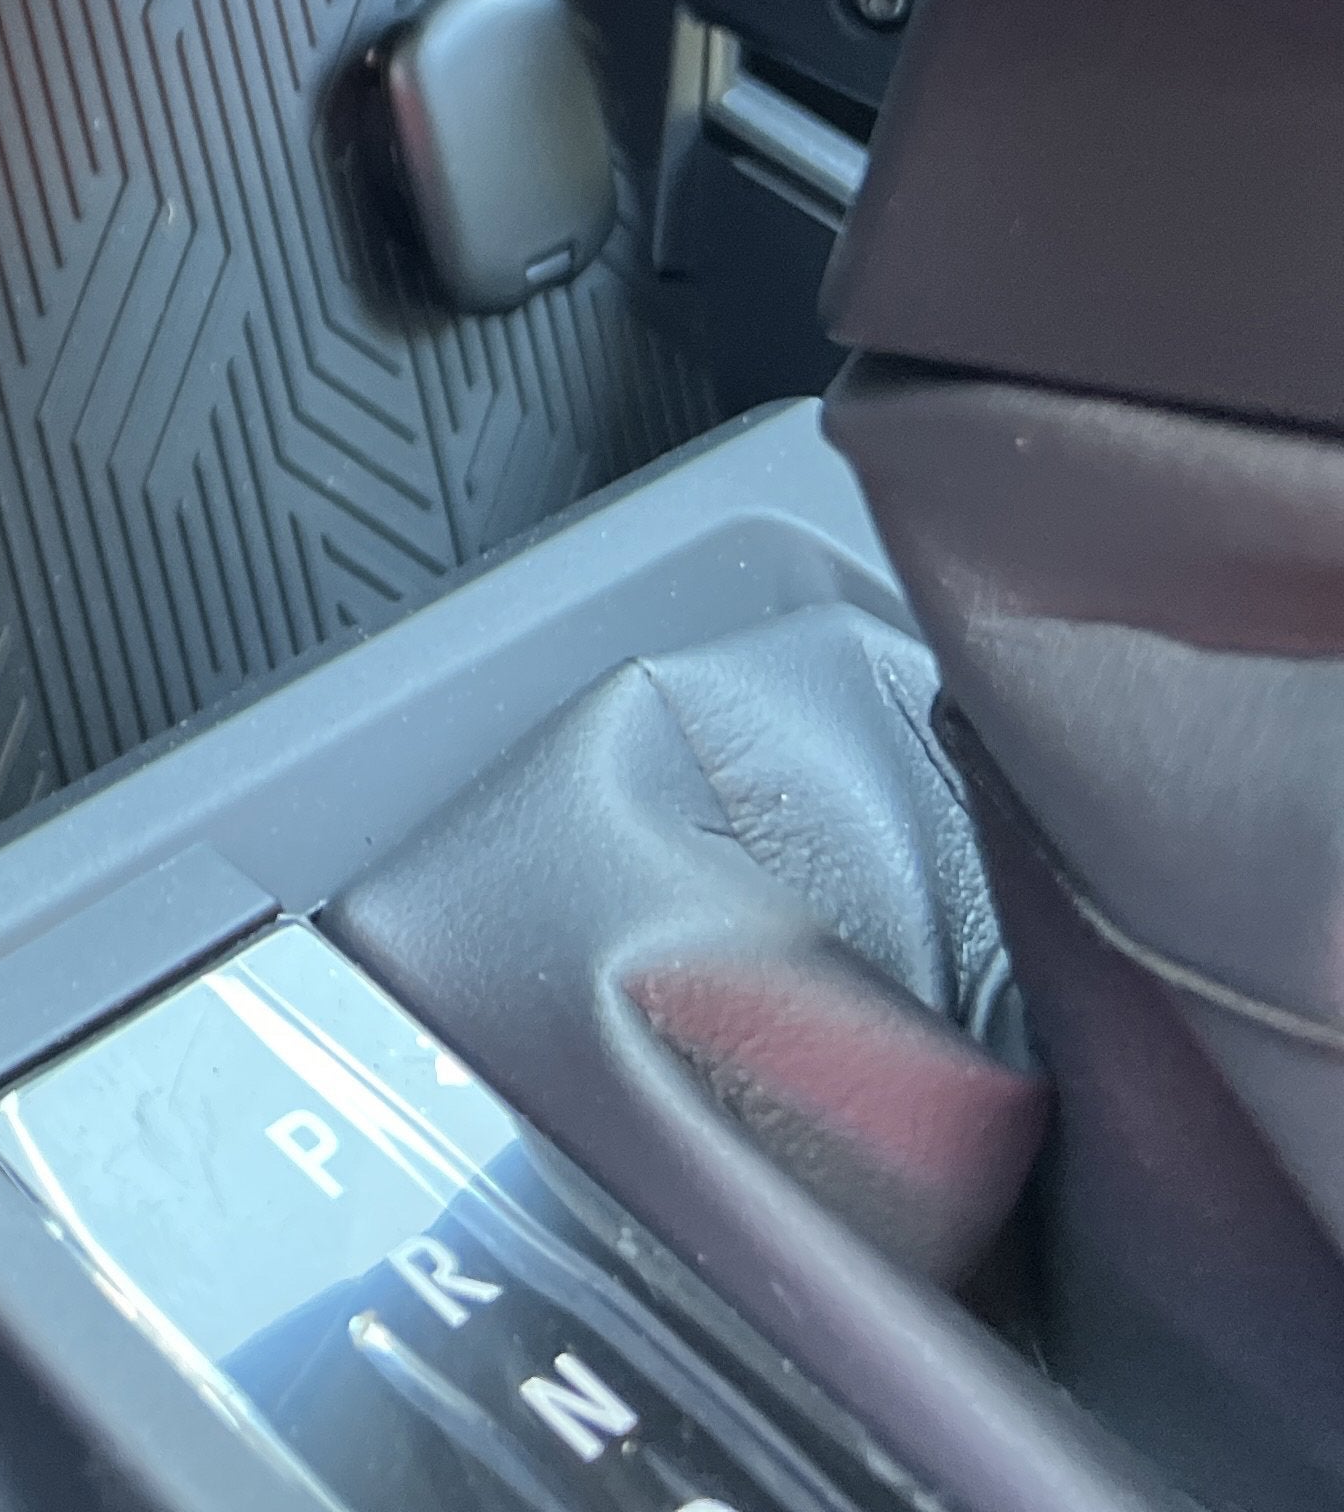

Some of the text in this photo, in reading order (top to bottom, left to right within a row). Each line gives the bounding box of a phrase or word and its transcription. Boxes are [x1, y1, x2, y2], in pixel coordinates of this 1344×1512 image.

[264, 1108, 345, 1200] P
[386, 1235, 503, 1329] R
[519, 1351, 639, 1463] N
